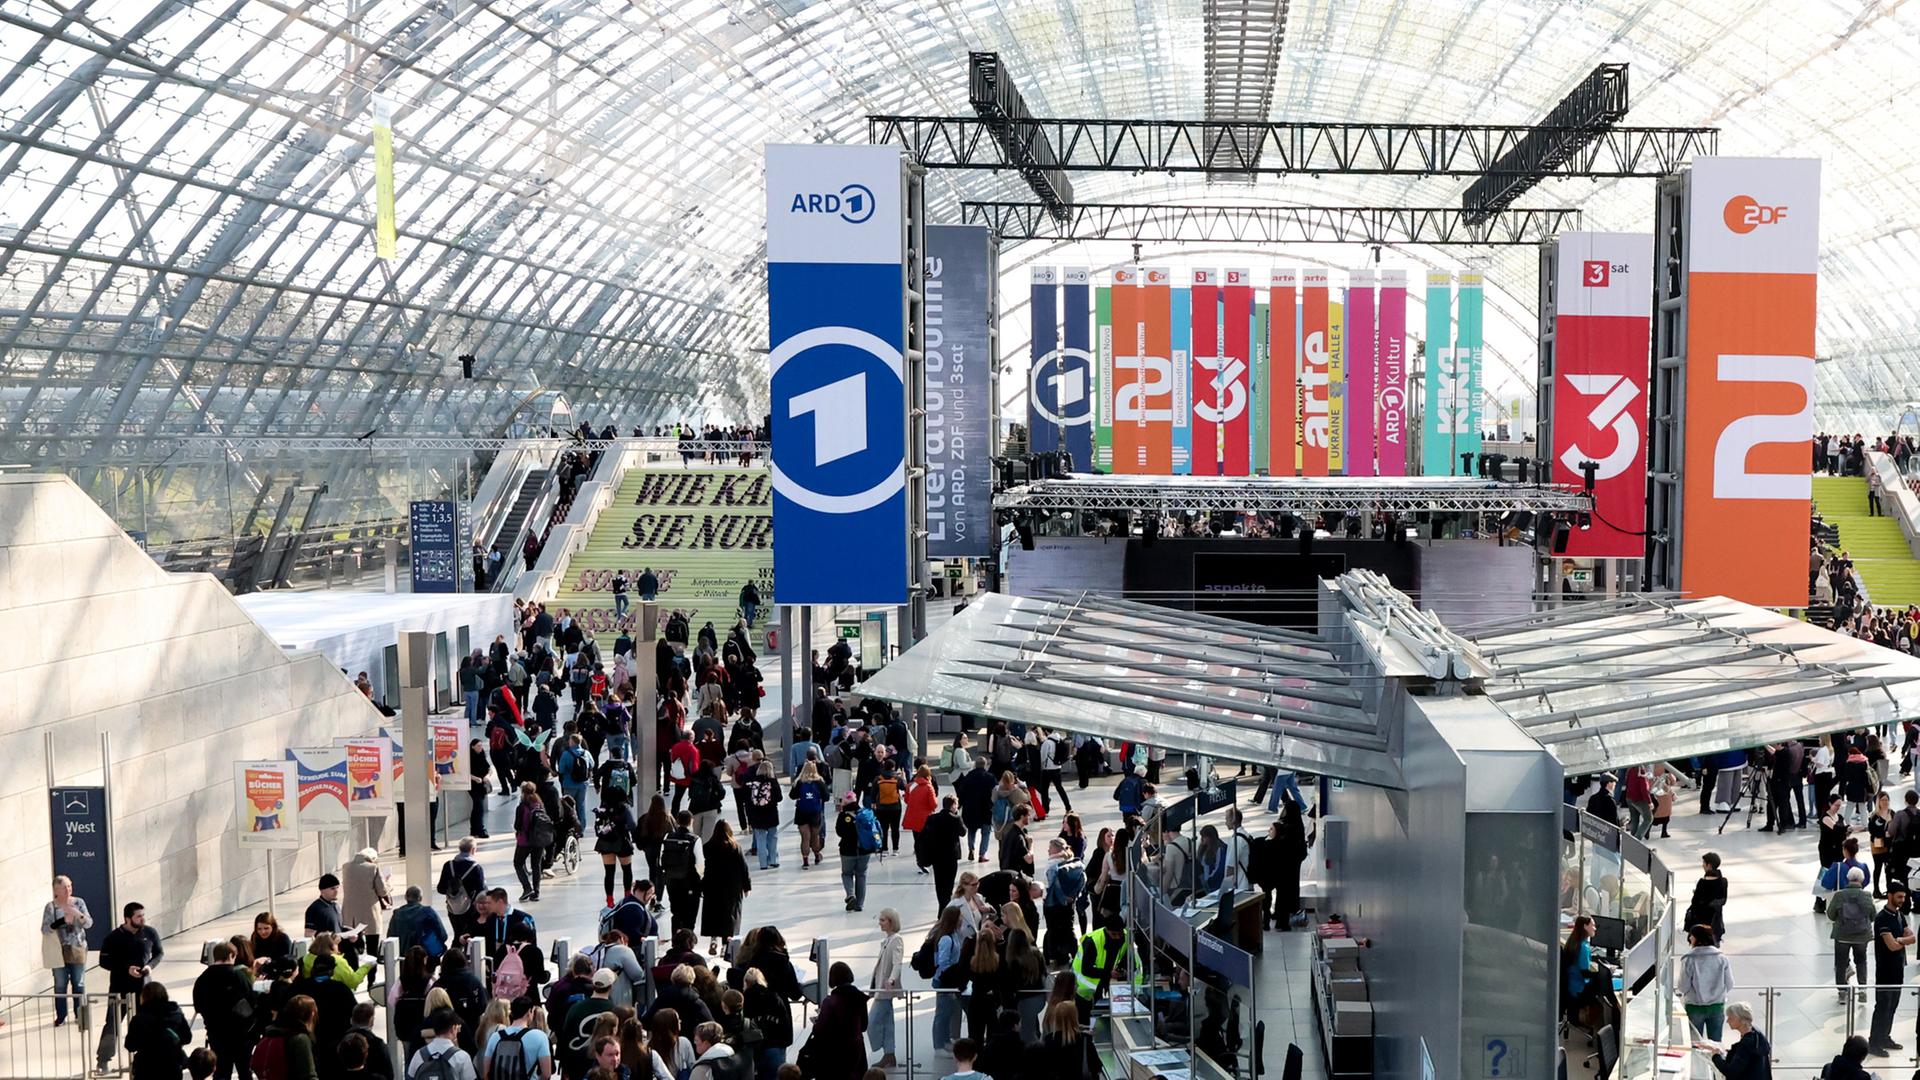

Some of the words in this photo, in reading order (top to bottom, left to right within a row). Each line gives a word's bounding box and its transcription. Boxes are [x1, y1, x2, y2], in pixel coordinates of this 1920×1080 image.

[791, 194, 841, 213] ARD
[1743, 205, 1789, 225] ZDF
[1332, 324, 1340, 332] 4
[950, 344, 964, 384] 3sat
[1331, 334, 1340, 369] HALLE
[1386, 336, 1400, 384] Kultur
[951, 388, 964, 421] und
[1103, 352, 1111, 425] Deutschlandfunk
[1176, 352, 1184, 425] Deutschlandfunk
[1303, 331, 1328, 449] arte
[951, 426, 965, 461] ZDF
[1331, 409, 1340, 459] UKRAINE
[1386, 410, 1400, 444] ARD
[633, 473, 714, 506] WIE
[709, 473, 773, 506] KA
[951, 465, 967, 506] ARD,
[432, 503, 445, 512] 2,4
[433, 513, 453, 523] 1,3,5
[621, 513, 695, 550] SIE
[954, 510, 966, 542] von
[248, 779, 282, 789] BÜCHER
[65, 821, 96, 833] West
[65, 833, 73, 846] 2
